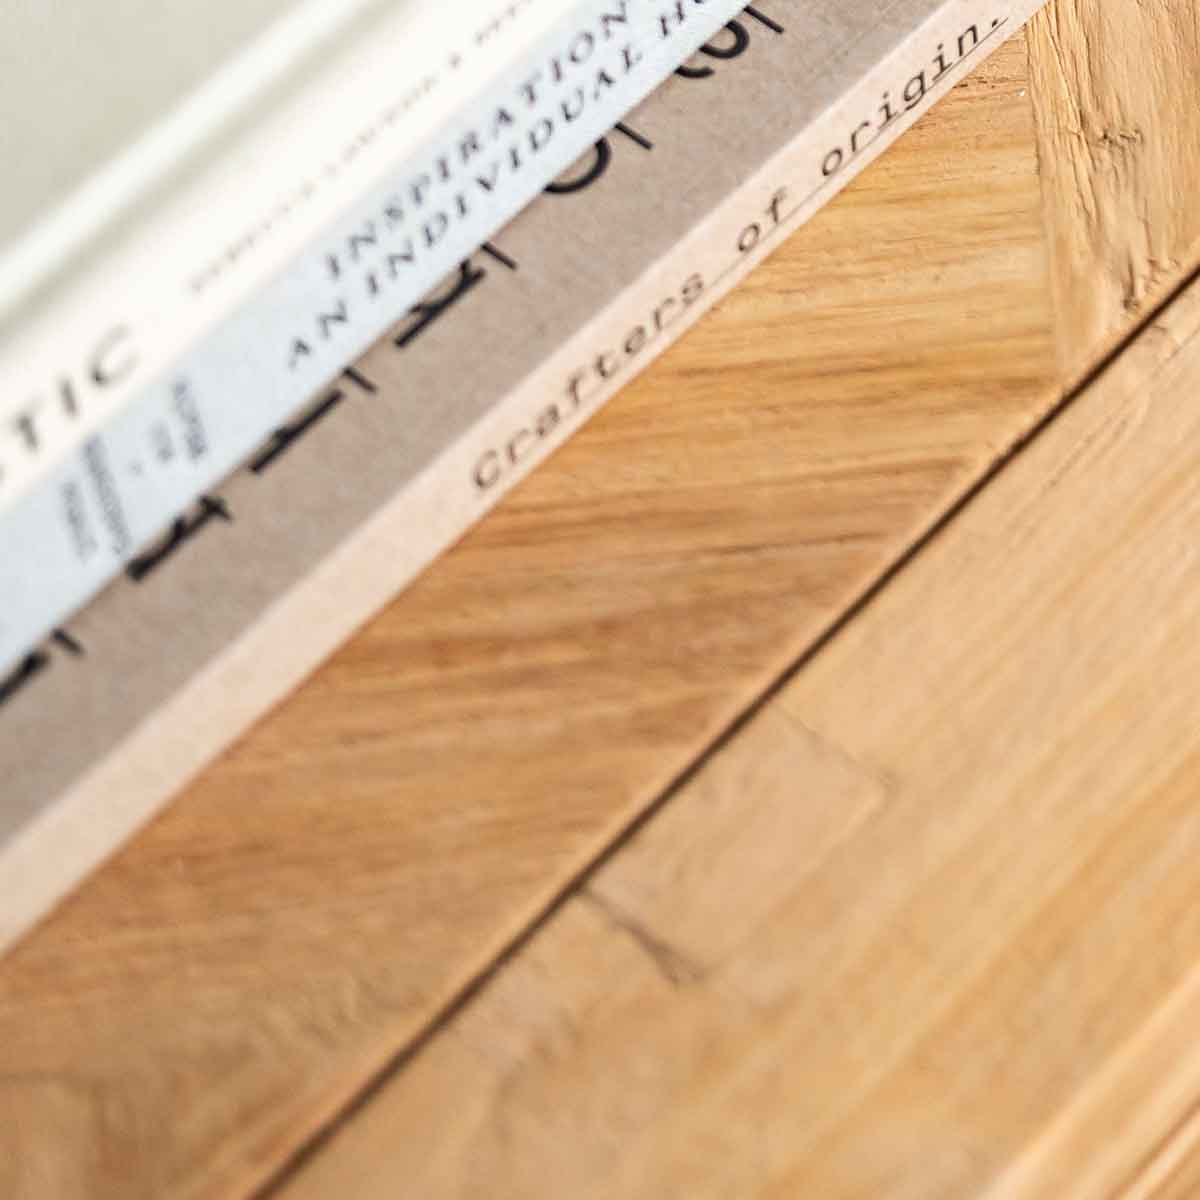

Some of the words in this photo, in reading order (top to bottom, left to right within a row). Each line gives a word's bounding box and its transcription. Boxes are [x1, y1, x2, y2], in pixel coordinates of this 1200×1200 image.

[289, 299, 349, 372] AN
[364, 42, 644, 297] INDIVIDUAL
[470, 272, 706, 492] Crafters
[736, 185, 788, 254] of
[820, 14, 1004, 179] origin.
[0, 324, 141, 472] TIC
